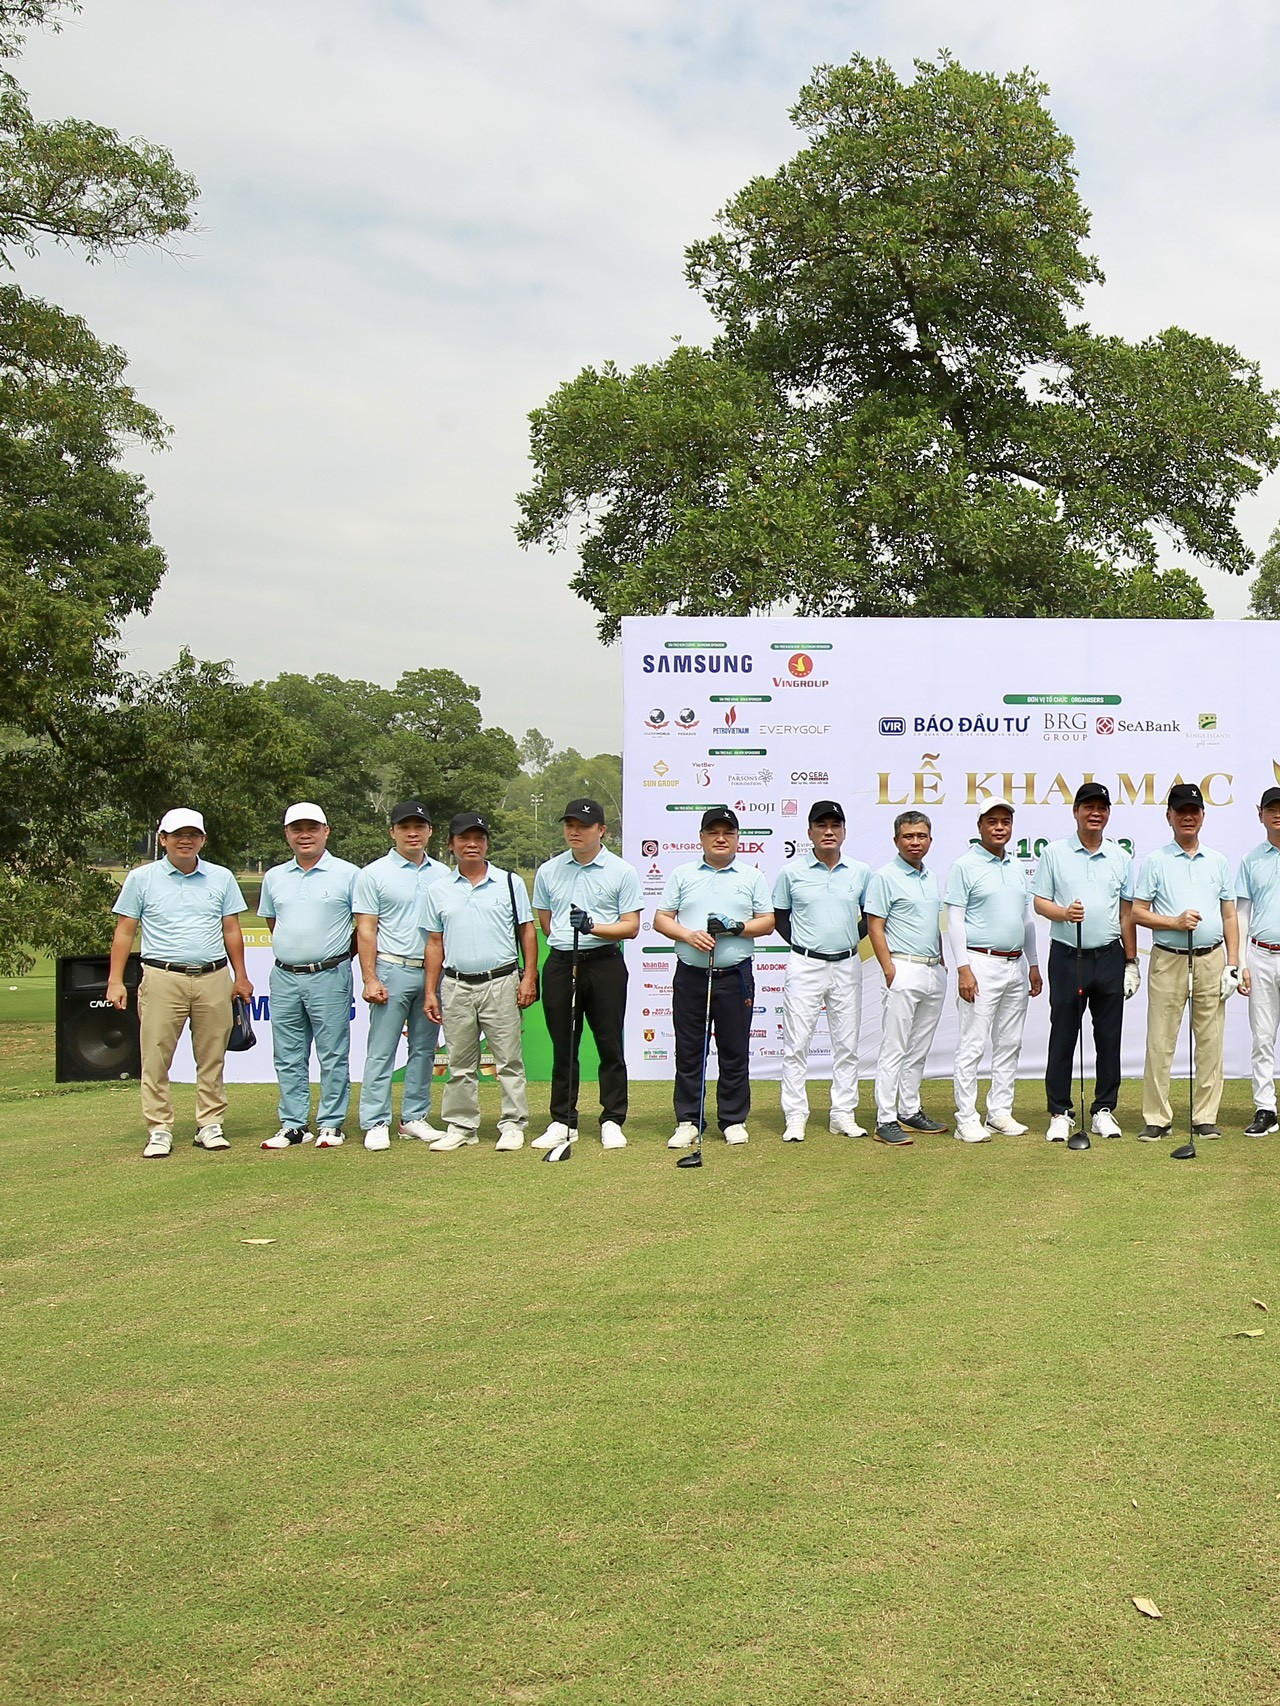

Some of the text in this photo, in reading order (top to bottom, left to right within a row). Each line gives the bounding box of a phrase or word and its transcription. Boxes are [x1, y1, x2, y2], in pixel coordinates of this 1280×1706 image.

[643, 654, 753, 673] SAMSUNG
[772, 677, 829, 688] VINGROUP
[883, 721, 902, 731] VIR
[914, 713, 1030, 732] BÁO ĐẦU TƯ
[1043, 713, 1087, 730] BRG
[1117, 720, 1181, 732] SeABank
[712, 727, 750, 735] PETROVIETNAM
[759, 725, 831, 735] EVERYGOLF
[875, 752, 946, 806] LỄ
[749, 802, 775, 815] DOJI
[662, 842, 703, 851] GOLFGRO
[736, 842, 765, 853] ELEX
[756, 963, 769, 971] LAO
